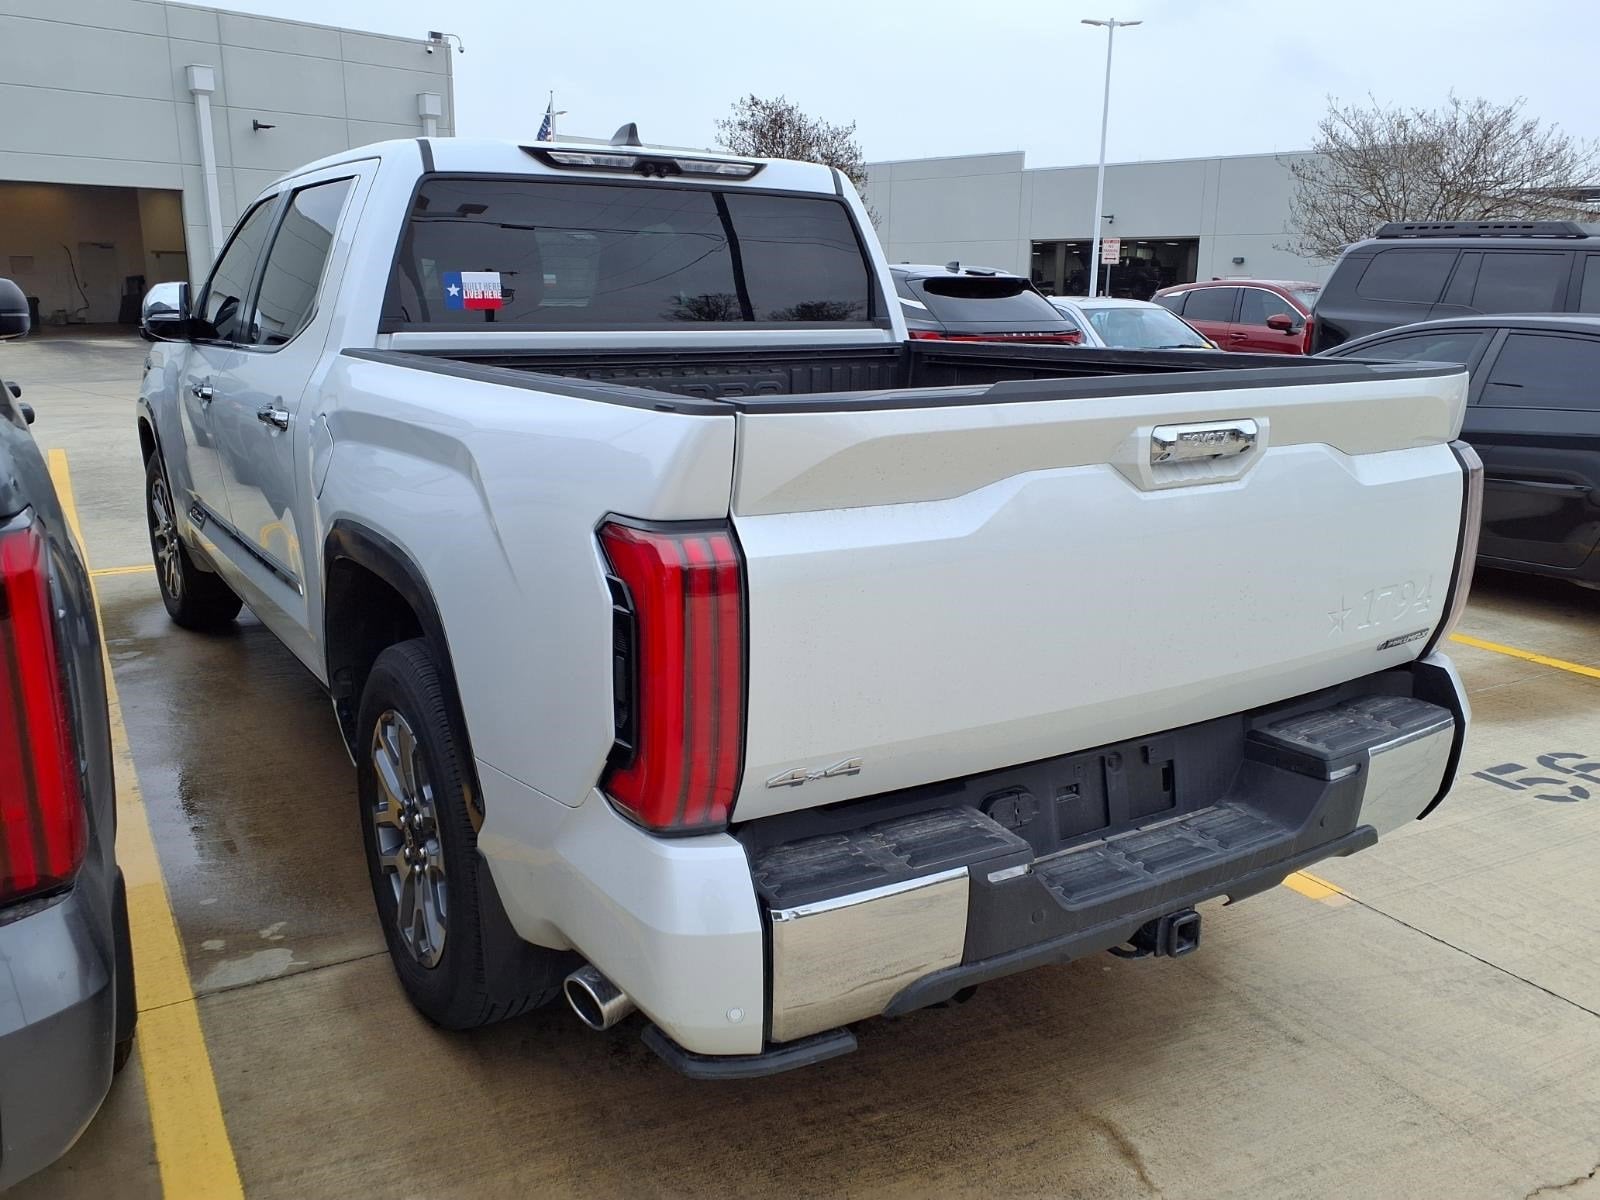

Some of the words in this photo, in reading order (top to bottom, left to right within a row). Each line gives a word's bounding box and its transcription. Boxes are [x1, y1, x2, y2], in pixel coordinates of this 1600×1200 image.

[463, 282, 481, 290] BUILT
[483, 282, 501, 290] HERE
[464, 290, 482, 299] LIVES
[484, 290, 502, 299] HERE
[1182, 431, 1231, 448] TOYOTA
[1357, 575, 1432, 630] 1794
